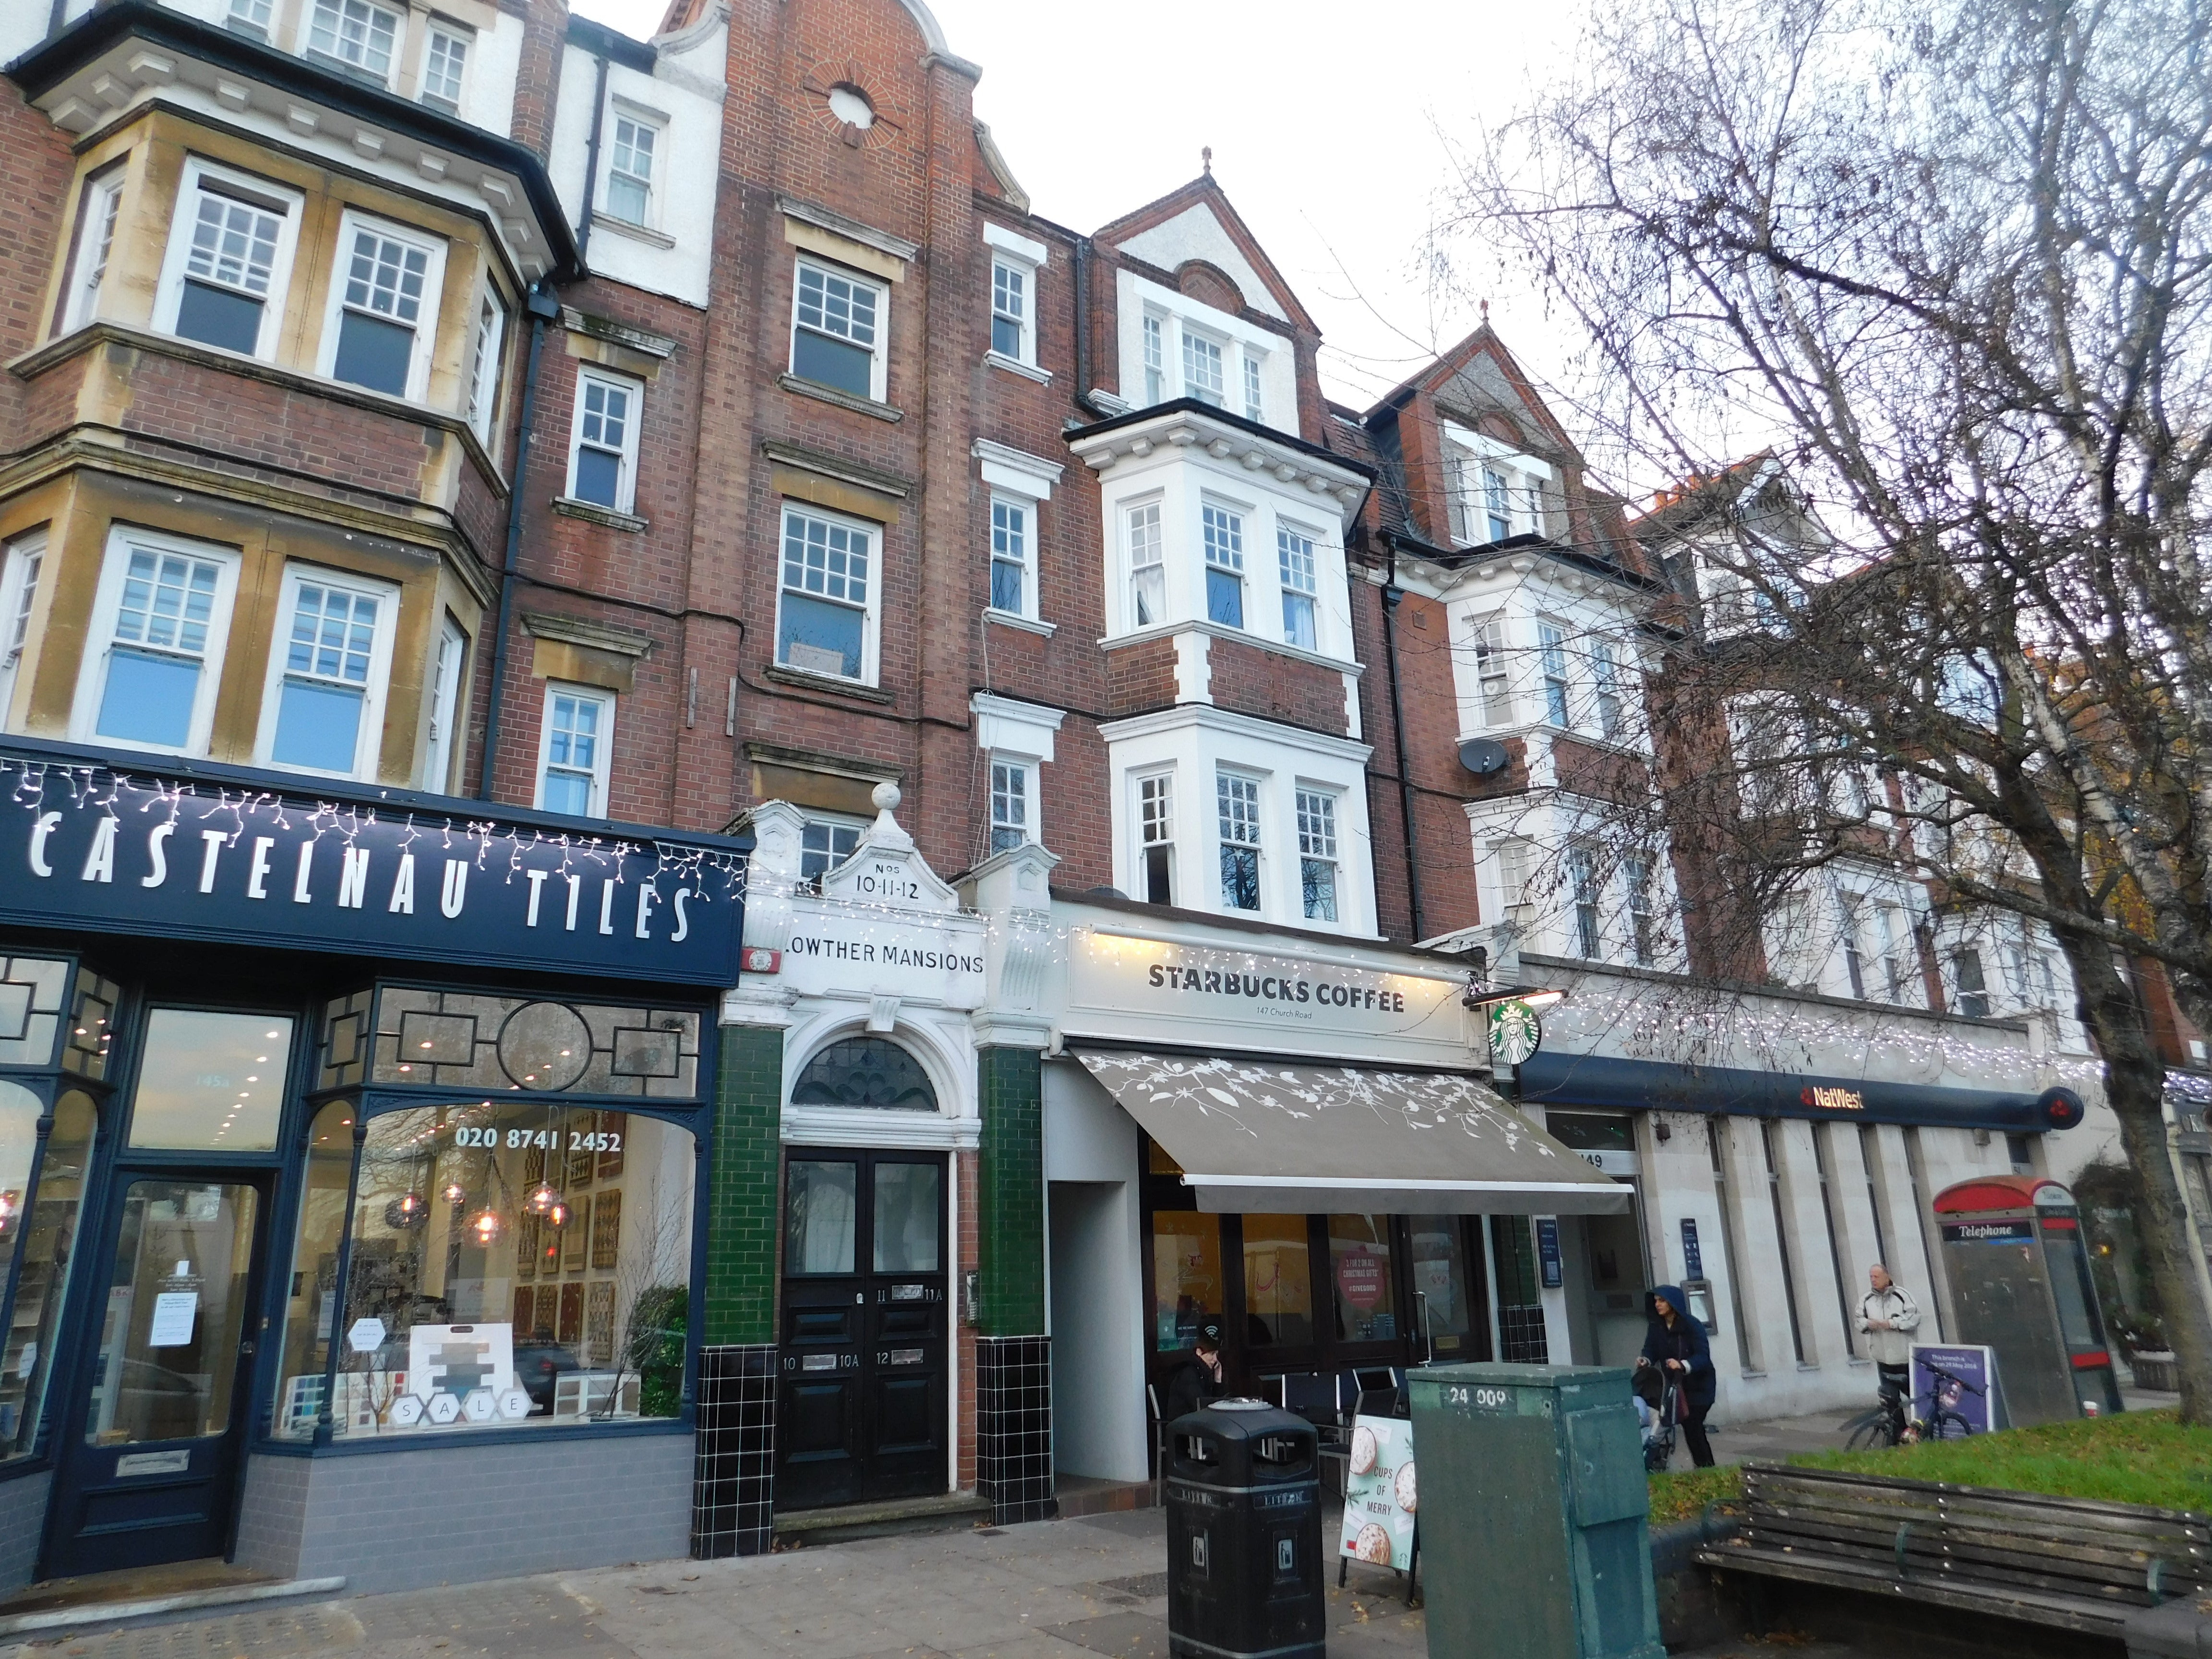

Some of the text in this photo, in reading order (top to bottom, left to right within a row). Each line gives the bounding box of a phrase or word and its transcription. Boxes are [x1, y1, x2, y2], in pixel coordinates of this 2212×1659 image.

[30, 811, 690, 942] CASTELNAU TILES
[857, 875, 919, 899] 10-11-12
[785, 937, 984, 973] OWTHER MANSIONS
[1149, 963, 1405, 1013] STARBUCKS COFFEE
[1257, 1006, 1312, 1019] 147 Church Road
[1813, 1086, 1864, 1109] NatWest
[456, 1127, 621, 1152] 020 8741 2452
[1959, 1225, 2012, 1238] Telephone
[877, 1288, 942, 1302] 11 11A
[783, 1354, 859, 1370] 10 10A
[876, 1352, 889, 1365] 12
[1450, 1387, 1506, 1406] 24 009
[1374, 1466, 1393, 1479] CUPS
[1377, 1484, 1386, 1496] OF
[1366, 1500, 1393, 1516] MERRY
